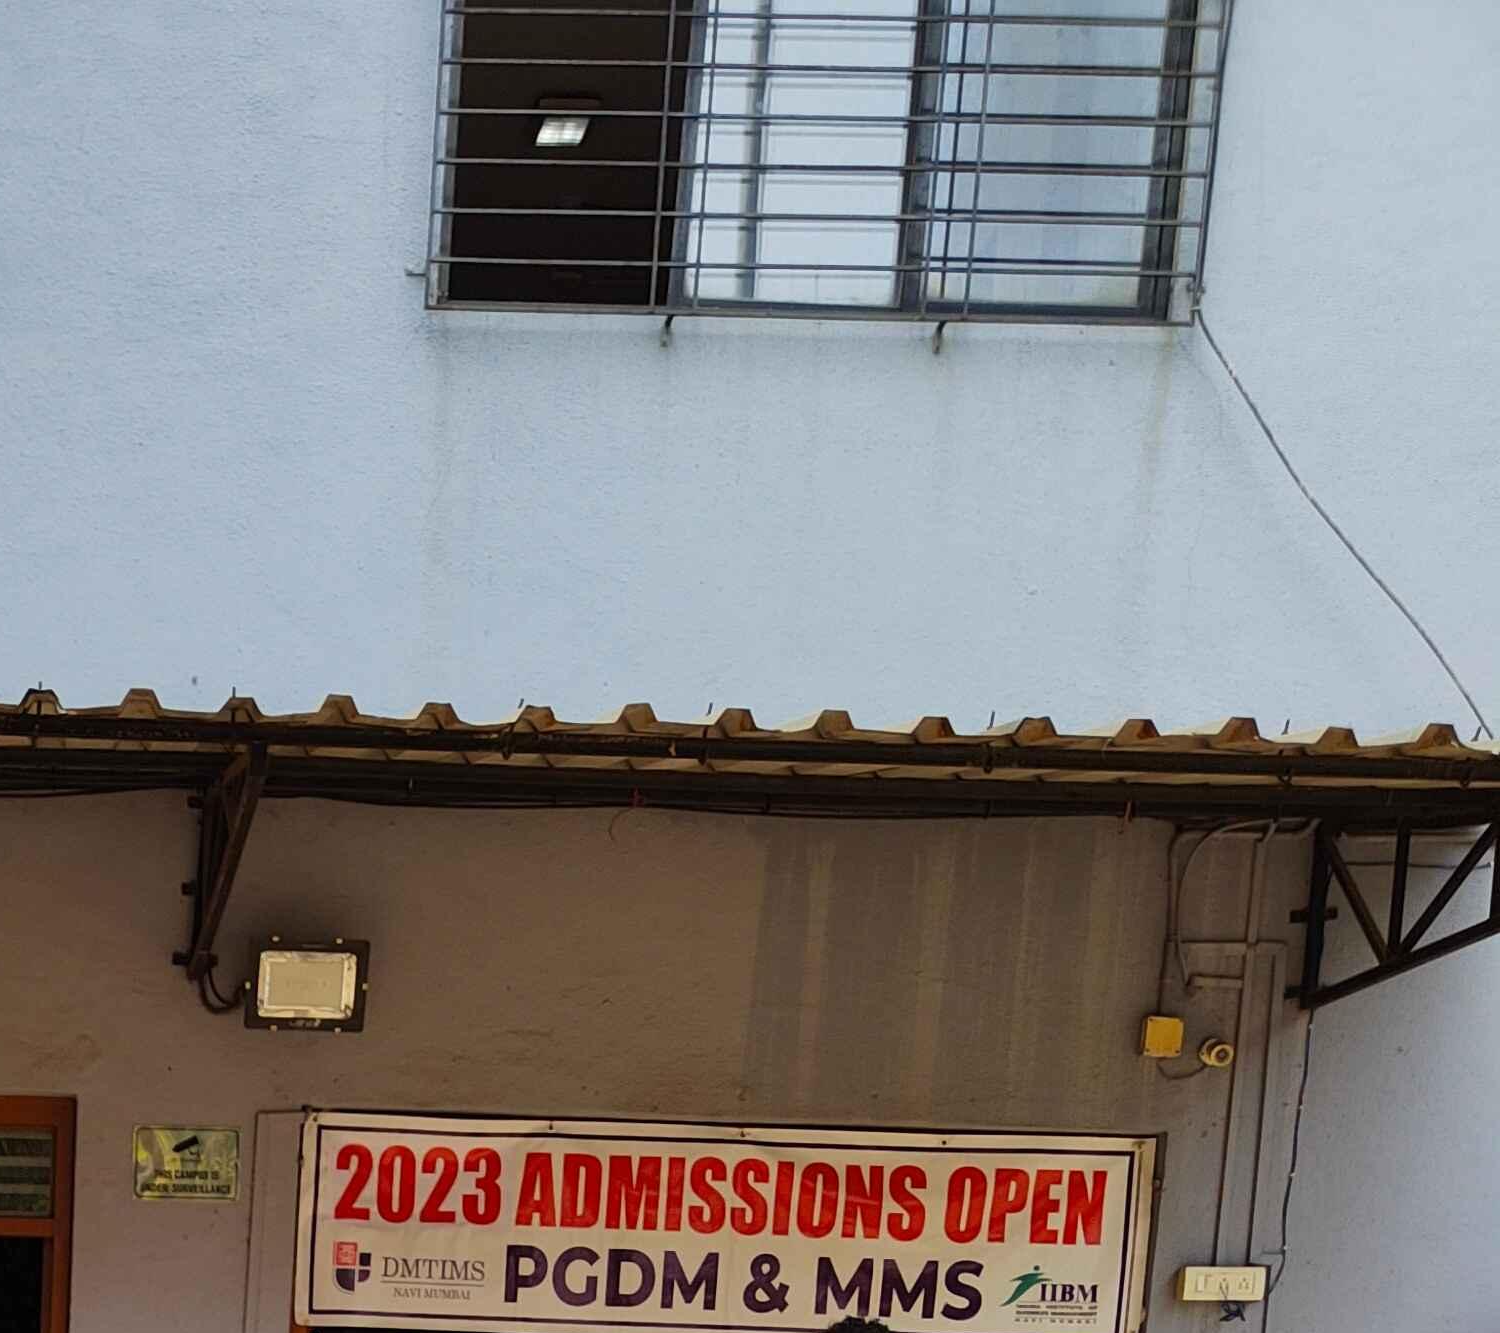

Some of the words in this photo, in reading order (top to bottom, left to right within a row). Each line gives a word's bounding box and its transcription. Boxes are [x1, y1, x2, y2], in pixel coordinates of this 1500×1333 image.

[334, 1143, 502, 1225] 2023
[515, 1151, 928, 1242] ADMISSIONS
[943, 1165, 1108, 1245] OPEN
[381, 1256, 485, 1282] DMTIMS
[393, 1287, 421, 1298] NAVI
[423, 1288, 471, 1300] MUMBAI
[503, 1244, 720, 1311] PGDM
[742, 1253, 790, 1313] &
[813, 1256, 984, 1321] MMS
[1040, 1283, 1098, 1303] IIBM
